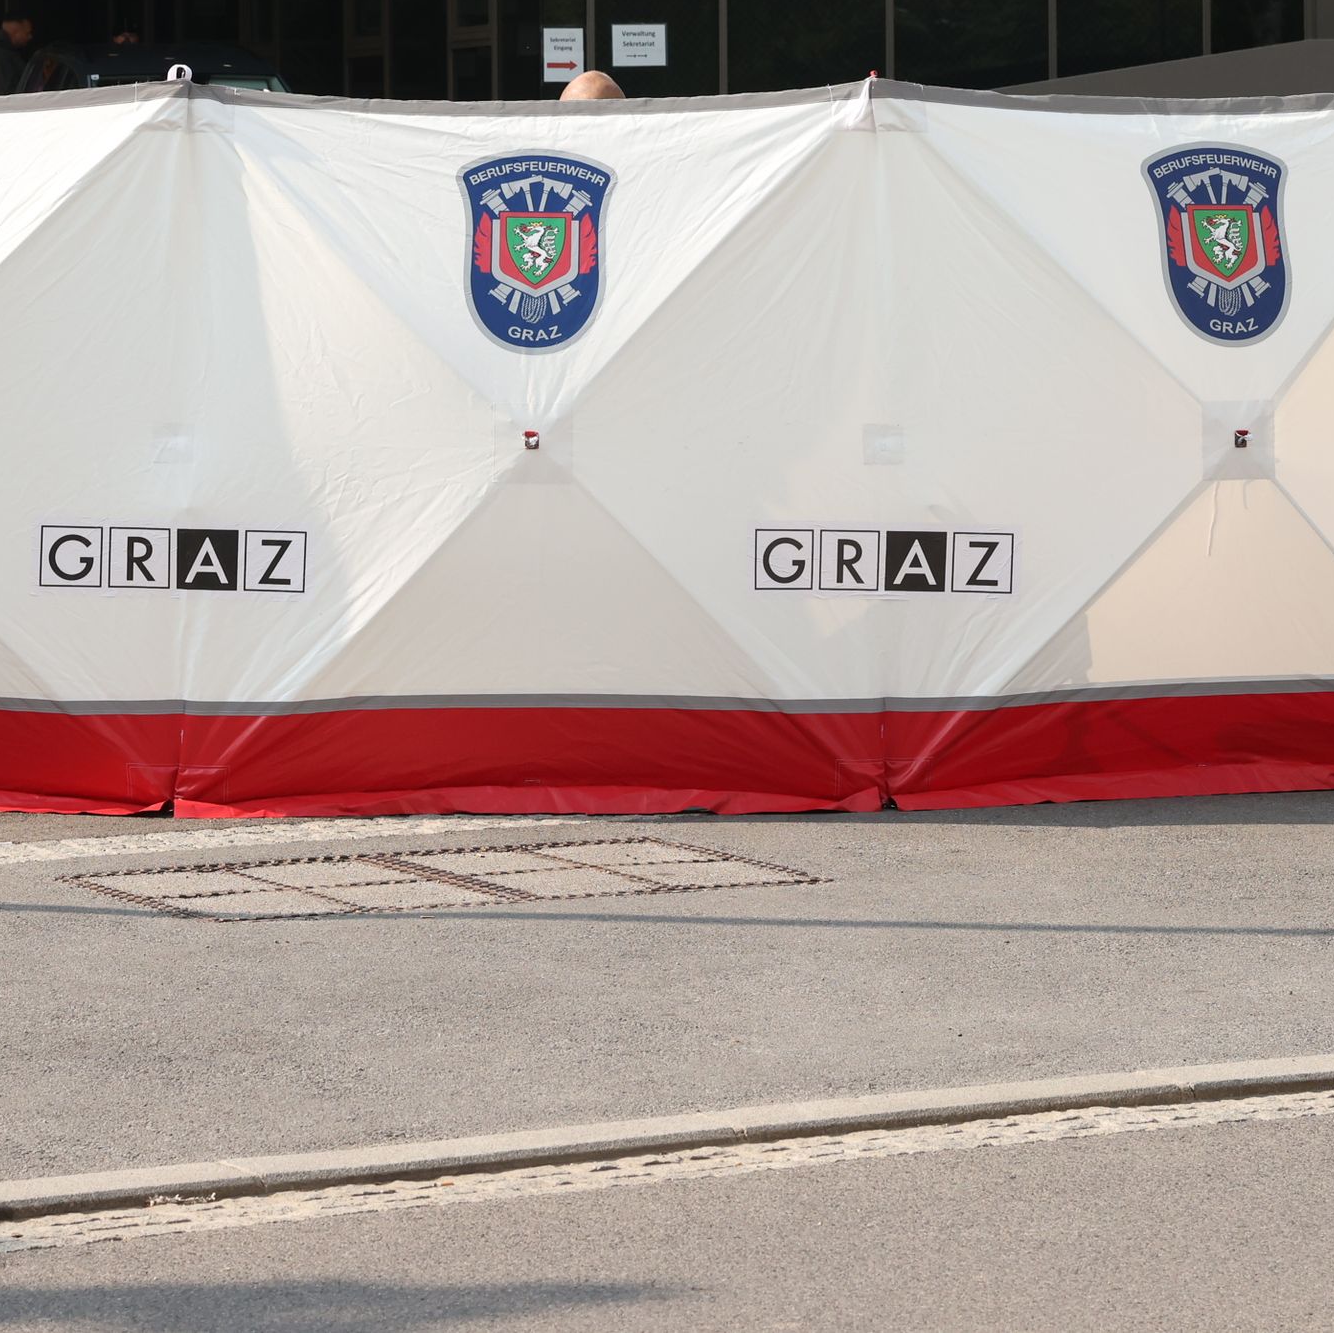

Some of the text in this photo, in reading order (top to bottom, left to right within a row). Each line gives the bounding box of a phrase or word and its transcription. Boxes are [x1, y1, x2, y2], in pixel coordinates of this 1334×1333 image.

[622, 30, 656, 38] Verwaltung
[469, 161, 606, 187] BERUFSFEUERWEHR
[1153, 154, 1278, 178] BERUFSFEUERWEHR
[508, 325, 562, 342] GRAZ
[1209, 317, 1259, 334] GRAZ
[48, 533, 294, 586] GRAZ
[762, 536, 1001, 587] GRAZ
